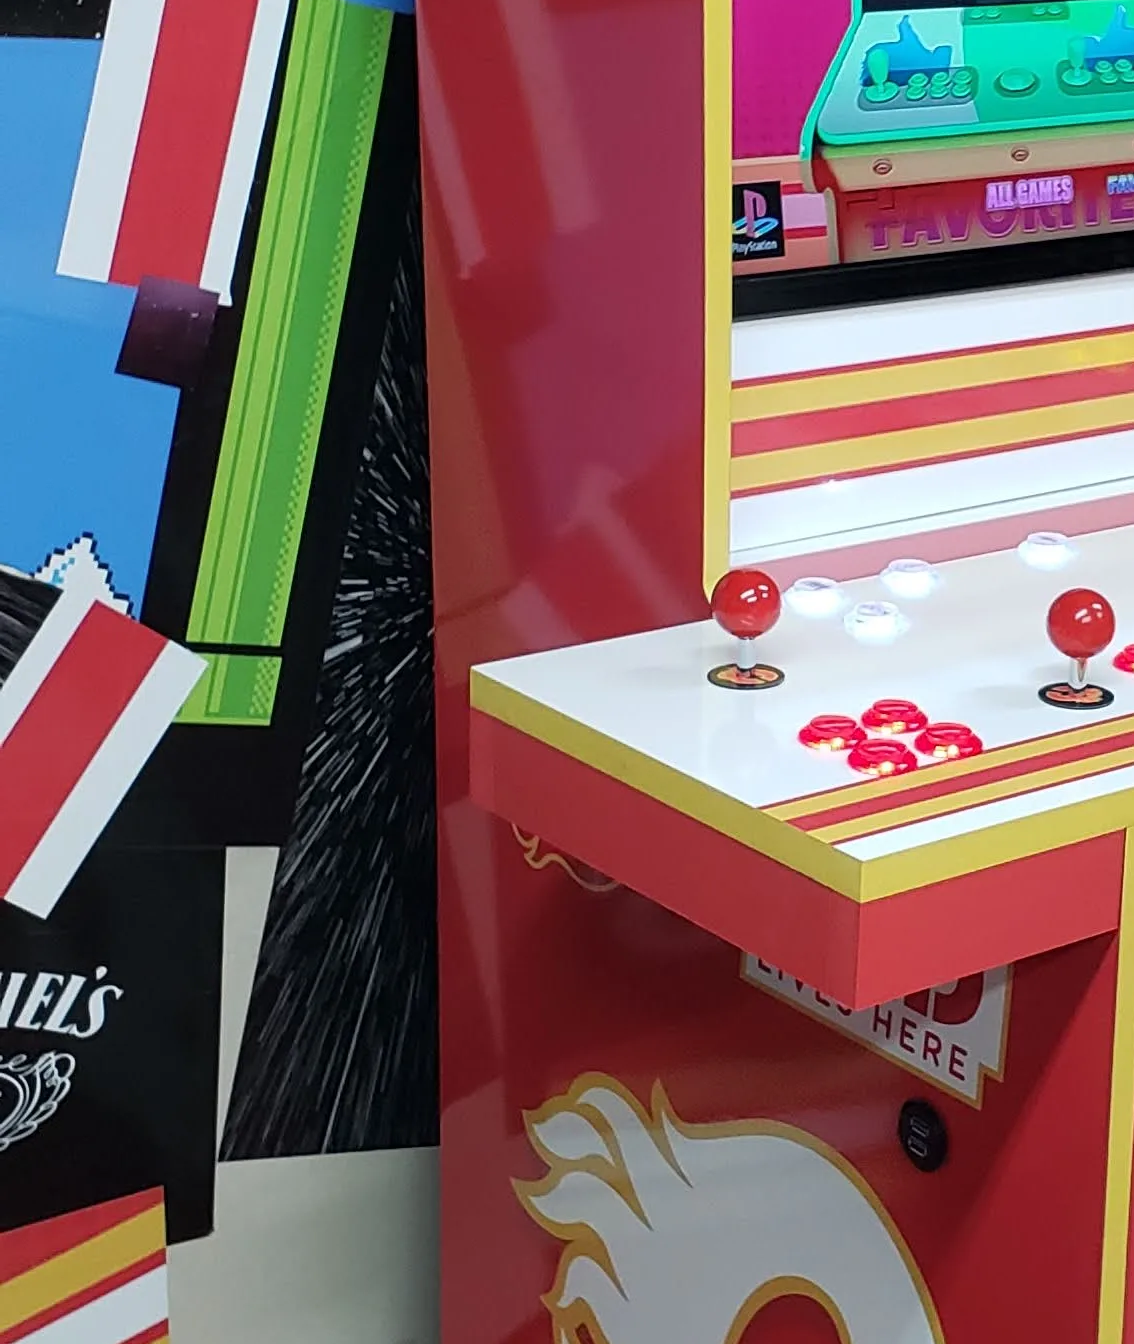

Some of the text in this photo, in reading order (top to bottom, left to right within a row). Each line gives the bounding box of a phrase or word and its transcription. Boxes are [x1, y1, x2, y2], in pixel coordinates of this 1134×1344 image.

[986, 175, 1074, 212] ALL GAMES
[0, 965, 124, 1039] IEL'S
[872, 1005, 969, 1082] HERE
